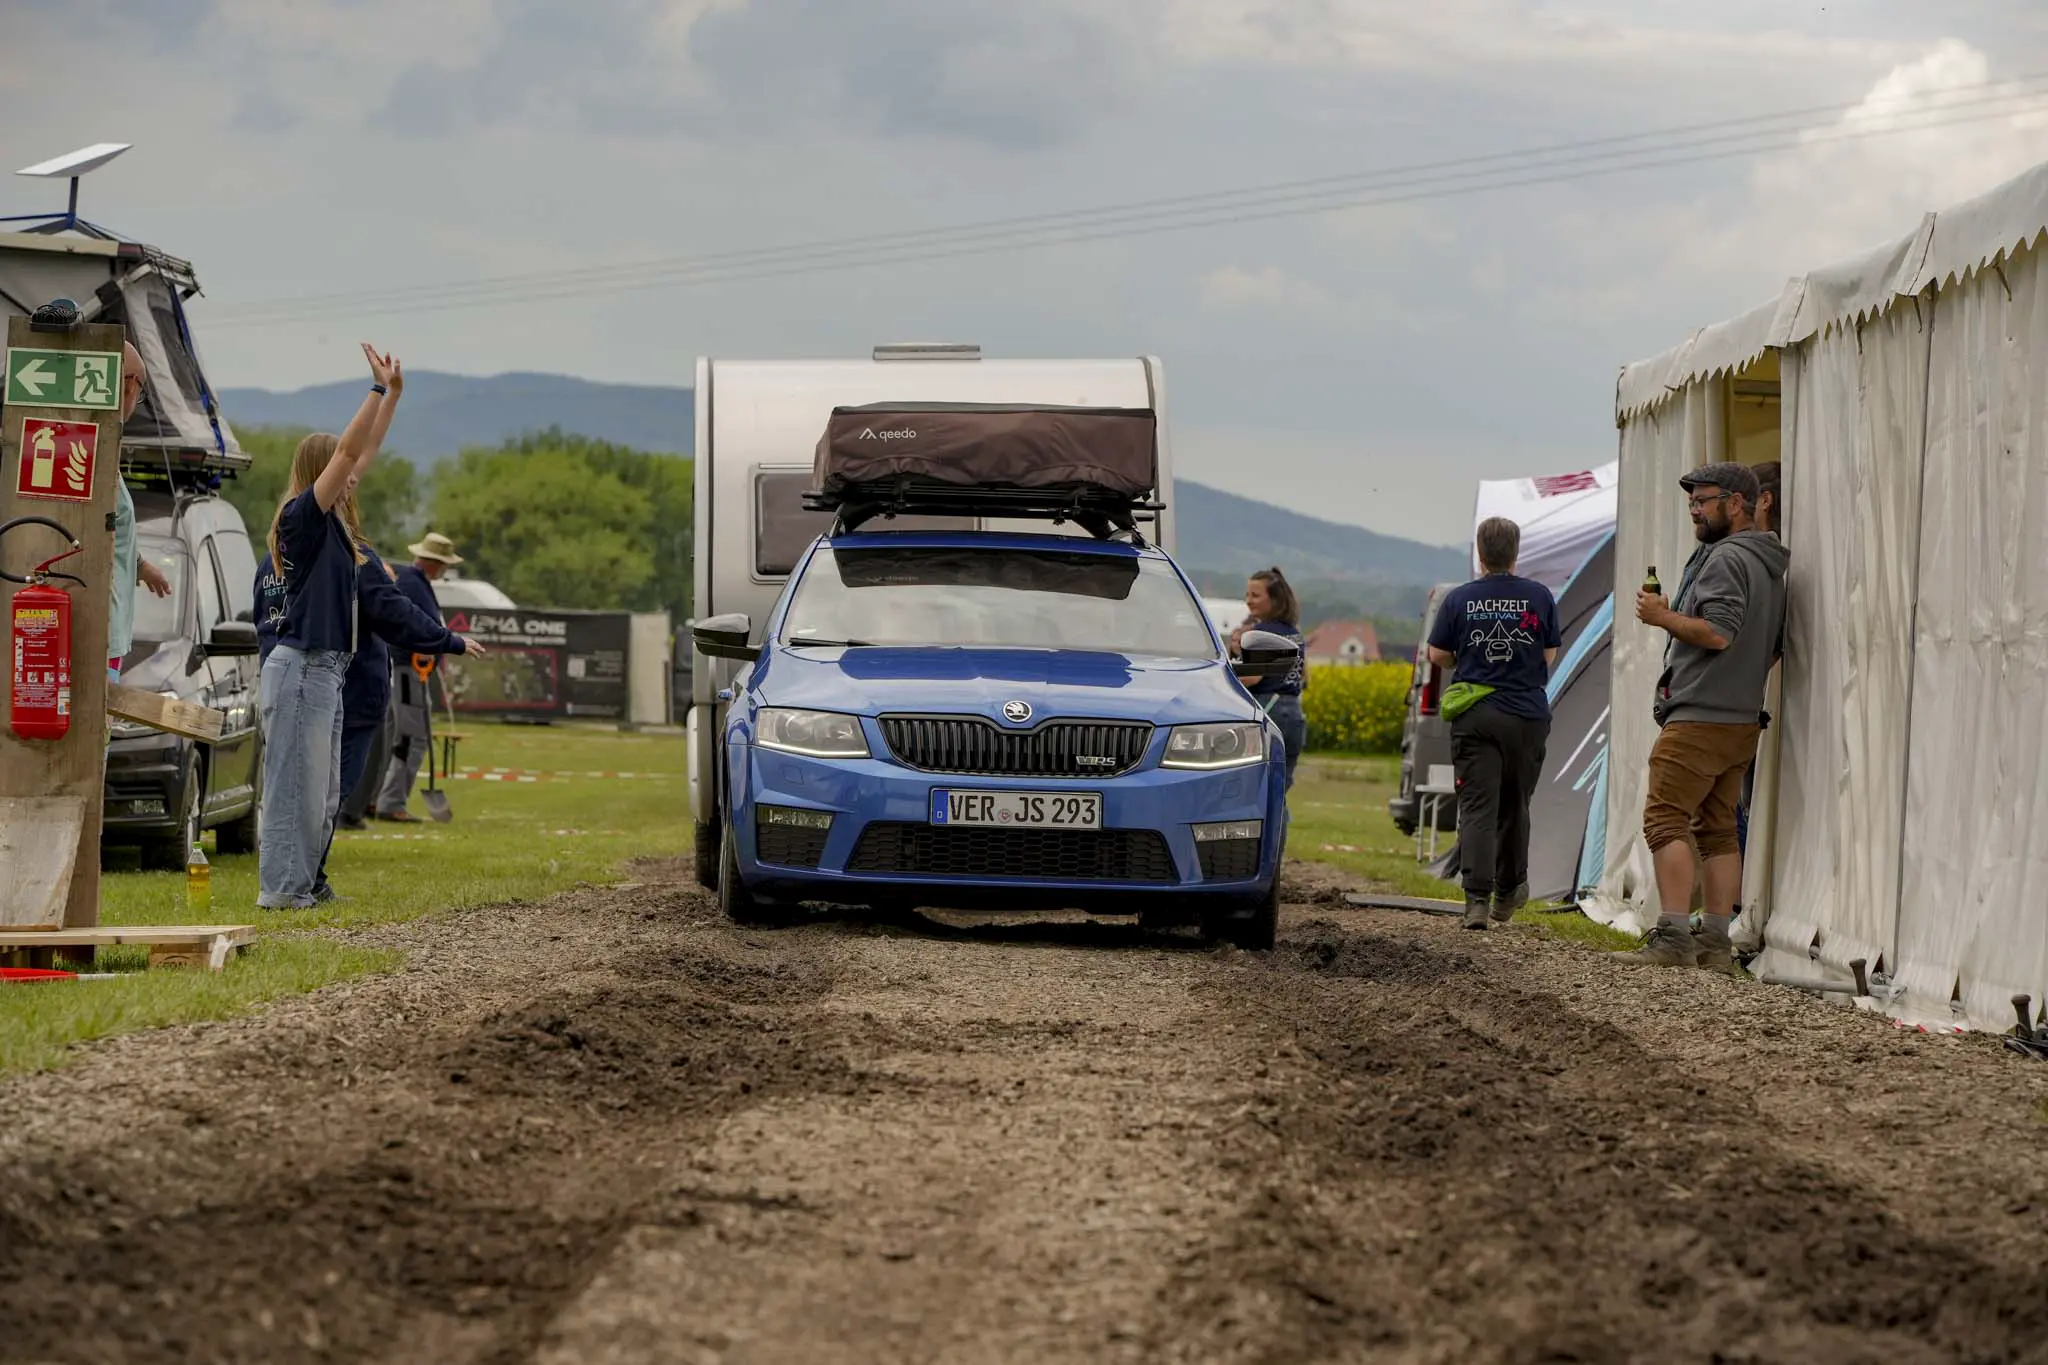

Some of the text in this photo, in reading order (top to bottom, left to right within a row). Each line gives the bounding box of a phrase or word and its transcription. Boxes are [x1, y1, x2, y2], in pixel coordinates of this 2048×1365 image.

[879, 427, 917, 443] qeedo
[1466, 599, 1529, 613] DACHZELT
[524, 619, 566, 635] ONE
[1466, 611, 1540, 633] FESTIVAL 24
[949, 795, 995, 822] VER
[1014, 797, 1045, 823] JS
[1051, 797, 1096, 825] 293
